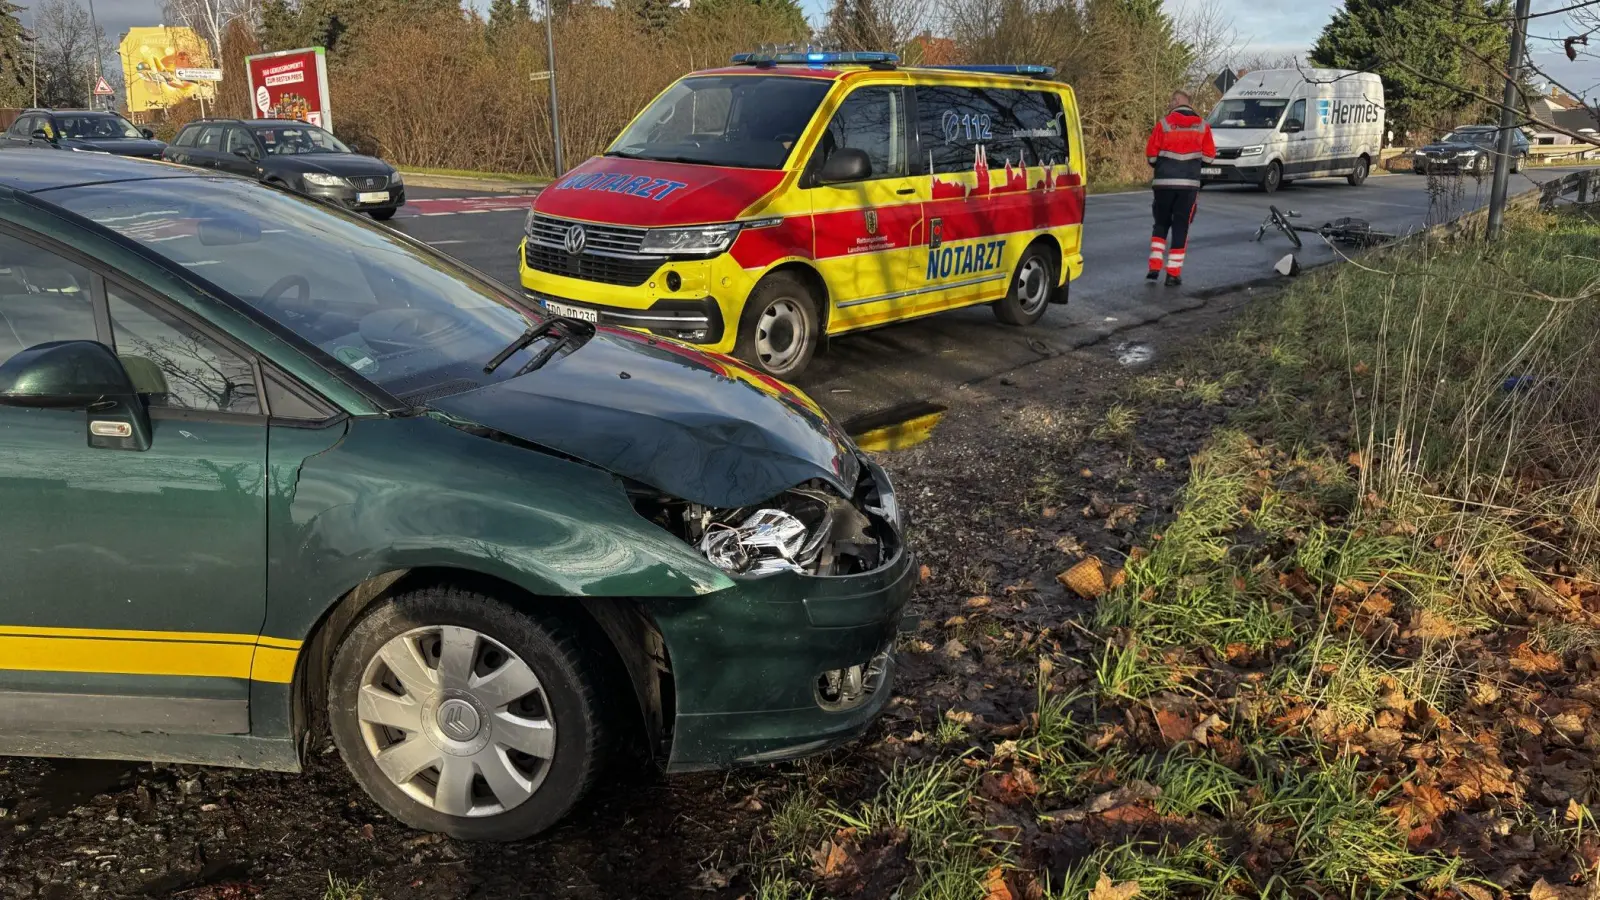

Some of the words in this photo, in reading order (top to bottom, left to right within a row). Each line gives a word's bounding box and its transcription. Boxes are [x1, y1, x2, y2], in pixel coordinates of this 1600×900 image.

[1331, 100, 1379, 124] Hermes
[961, 113, 993, 140] 112
[555, 172, 688, 201] NOTARZT
[926, 240, 1007, 280] NOTARZT
